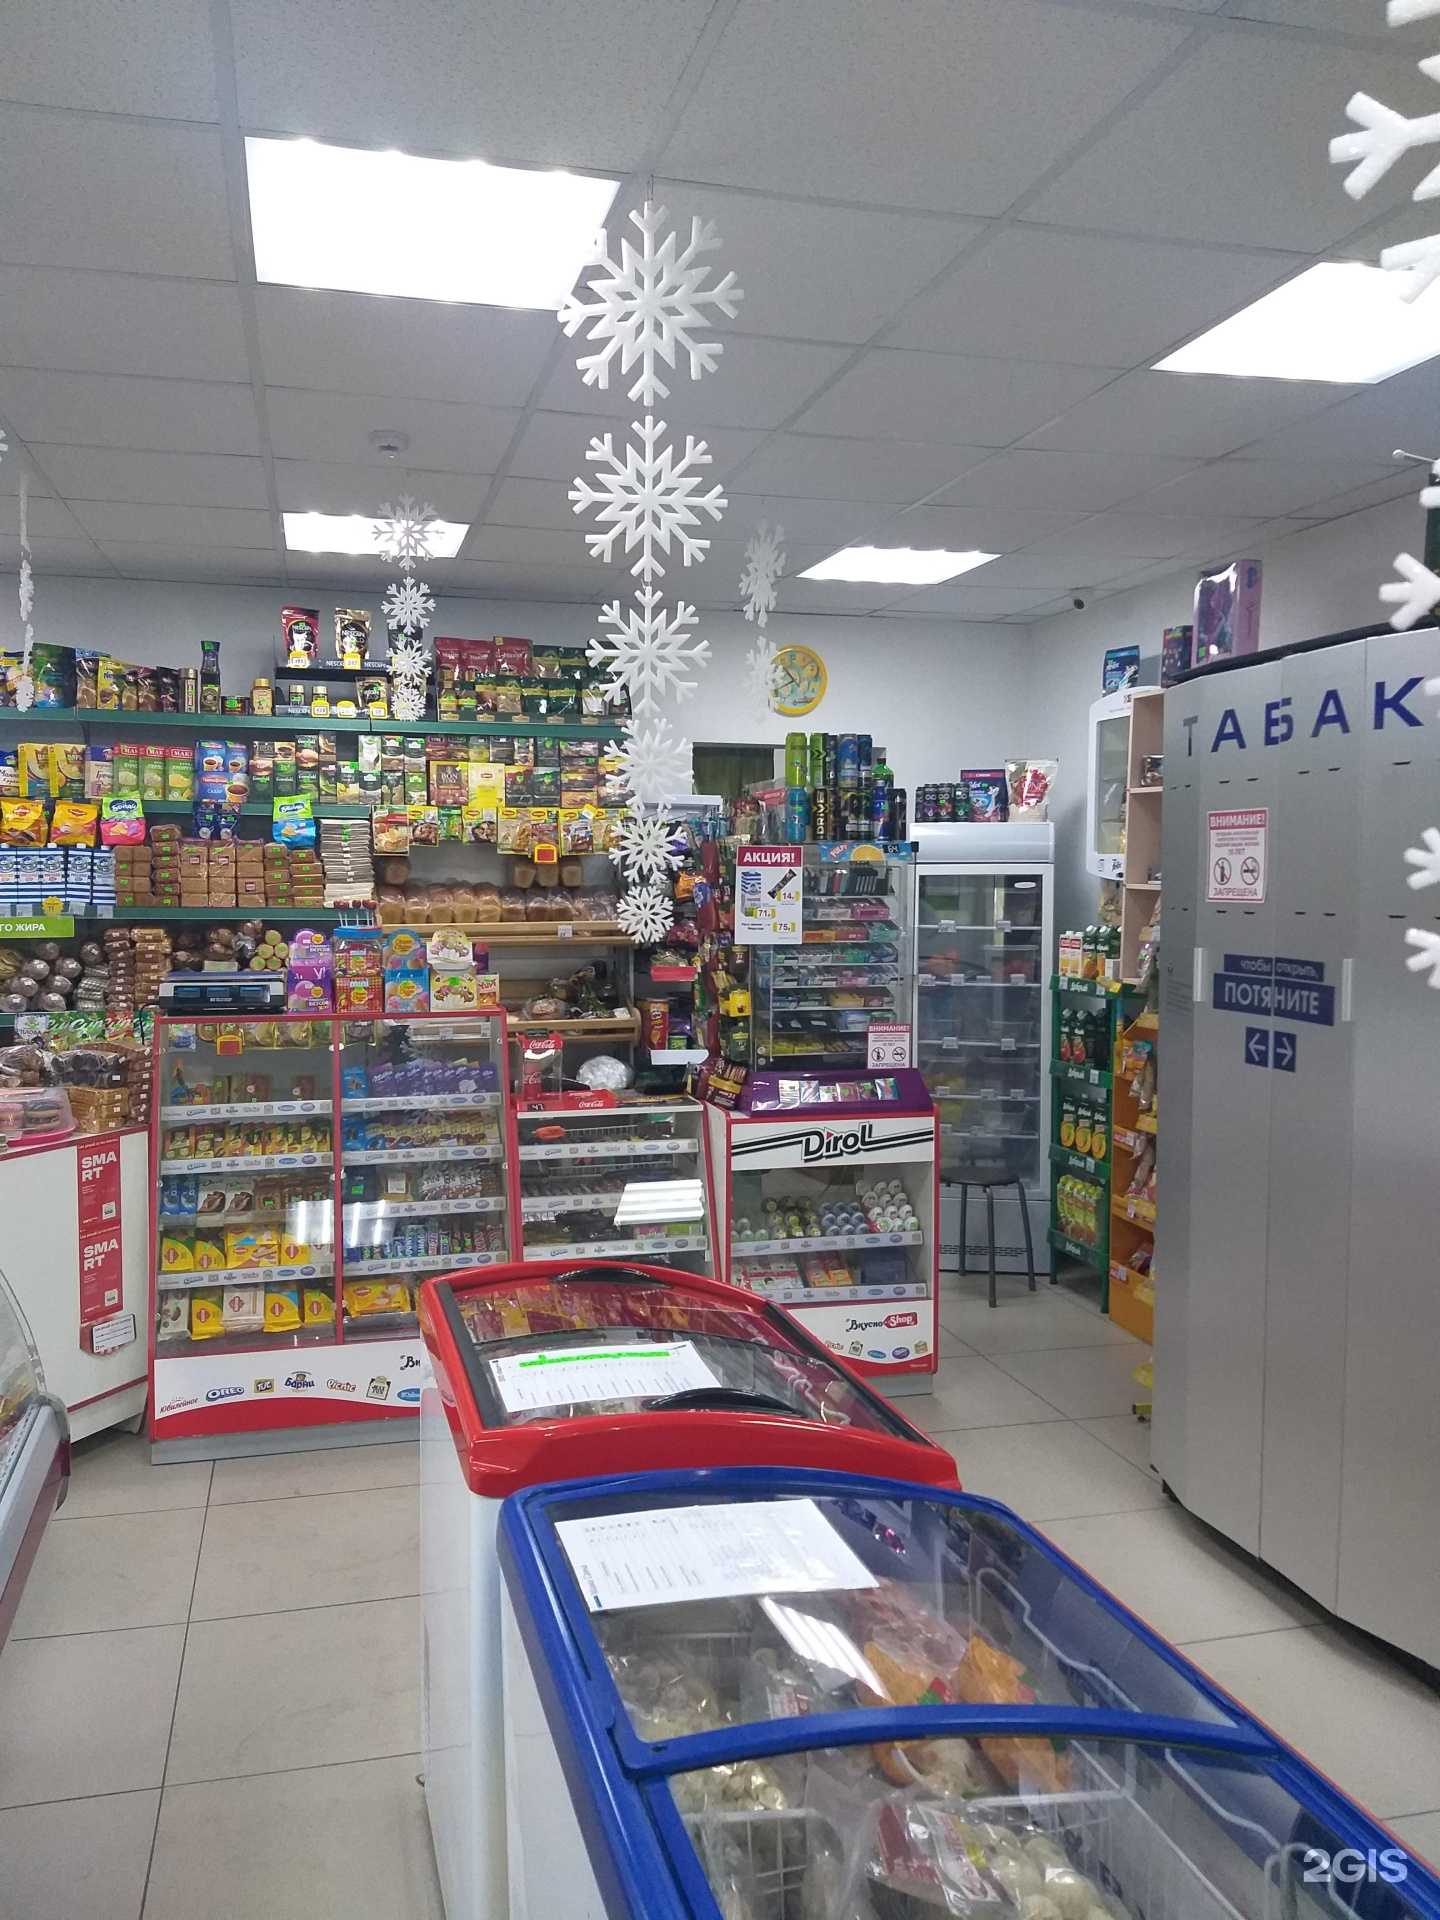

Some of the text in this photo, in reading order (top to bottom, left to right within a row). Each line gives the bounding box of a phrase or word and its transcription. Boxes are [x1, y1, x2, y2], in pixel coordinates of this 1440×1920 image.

[1183, 677, 1424, 757] ТАБАК
[1209, 813, 1265, 827] ВНИМАНИЕ!
[743, 852, 795, 864] АКЦИЯ!
[1213, 887, 1258, 897] ЗАПРЕЩЕНА
[16, 923, 46, 932] ЖИРА
[1240, 959, 1271, 973] чтобы
[1224, 981, 1320, 1015] ПОТЯНИТЕ
[801, 1121, 874, 1163] Dirol
[81, 1152, 117, 1169] SMA
[81, 1167, 103, 1182] RT
[83, 1238, 119, 1258] SMA
[83, 1255, 105, 1272] RT
[845, 1318, 884, 1332] Вкусно
[889, 1314, 914, 1328] Shop
[284, 1377, 316, 1389] Барни
[206, 1386, 245, 1401] OREO
